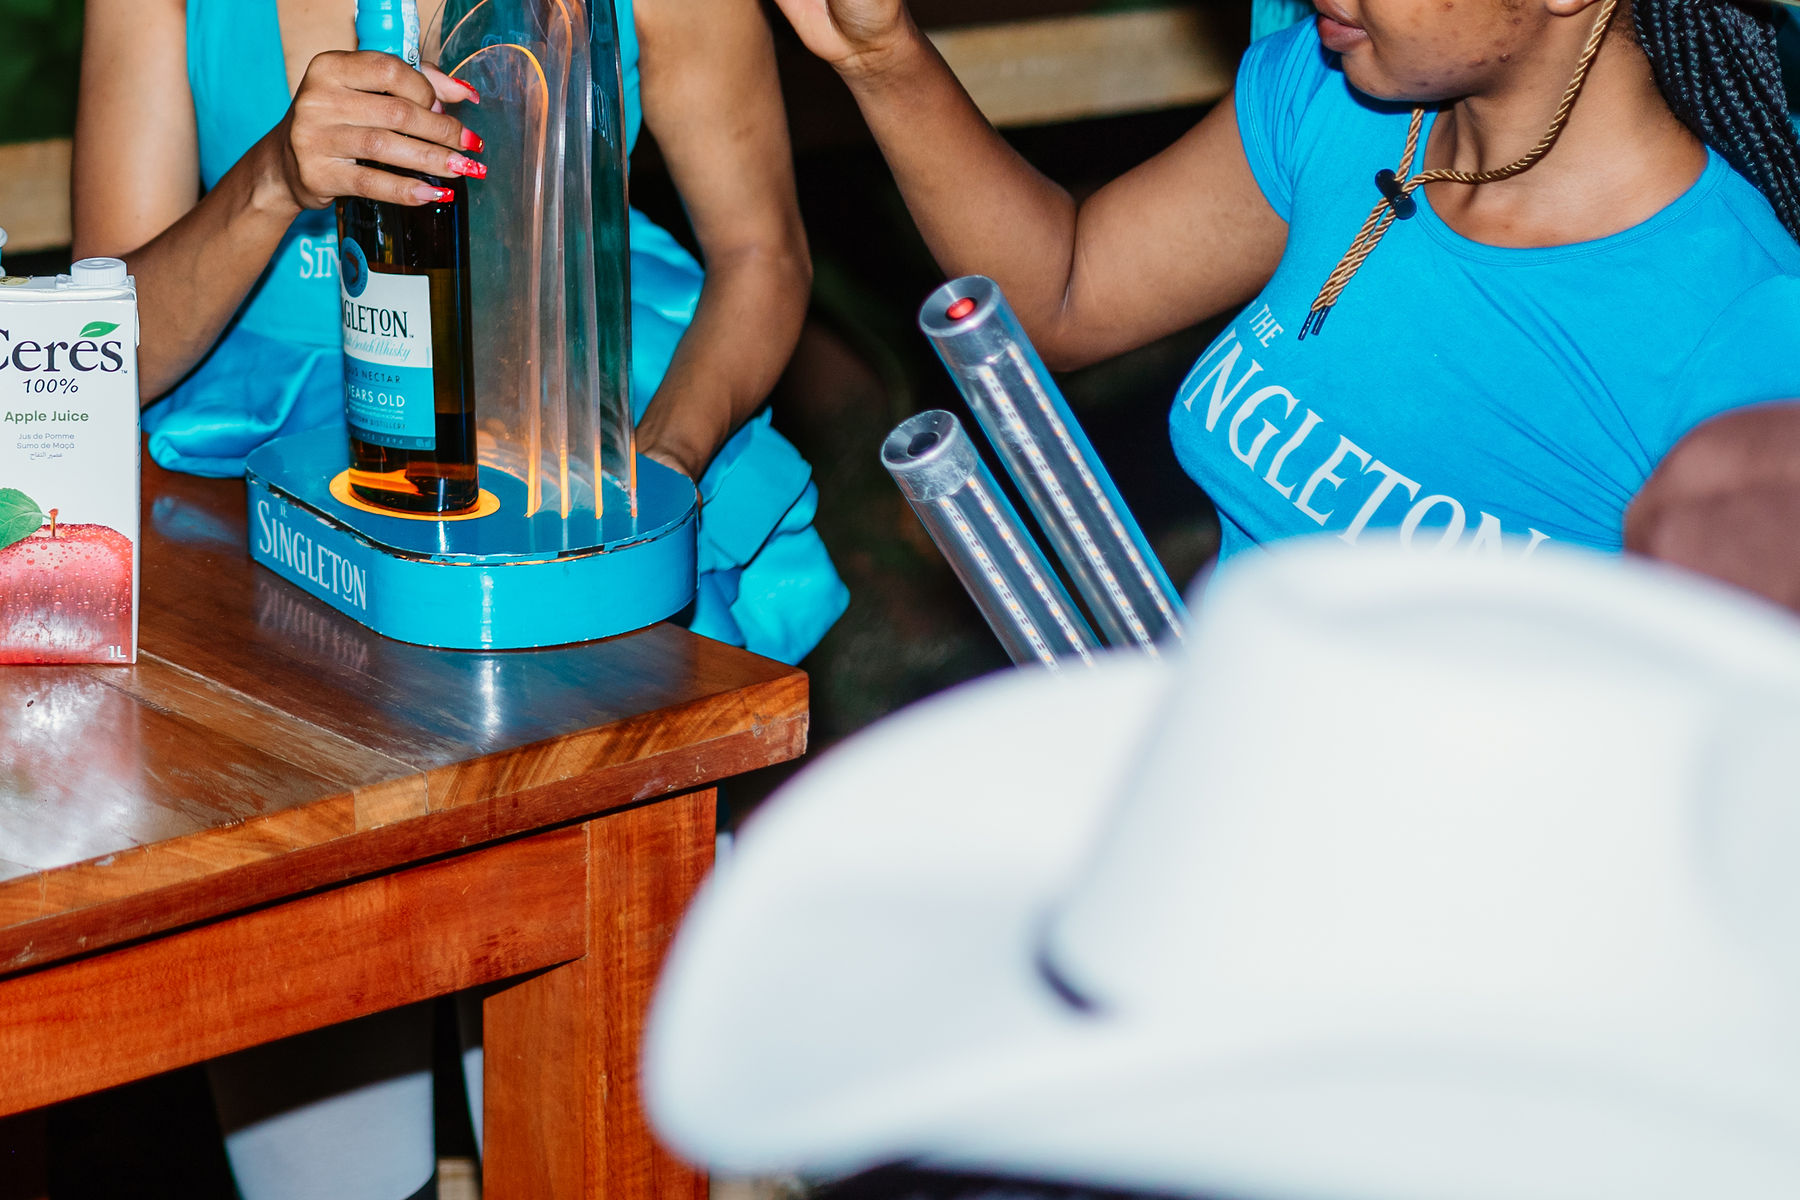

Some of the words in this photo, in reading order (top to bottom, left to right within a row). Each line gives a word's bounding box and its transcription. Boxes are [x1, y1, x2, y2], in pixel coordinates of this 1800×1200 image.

[300, 238, 341, 279] SIN
[343, 299, 408, 338] GLETON
[1249, 303, 1284, 348] THE
[361, 370, 401, 384] NECTAR
[23, 378, 79, 395] 100%
[378, 393, 405, 407] OLD
[4, 410, 47, 424] Apple
[51, 409, 89, 422] Juice
[258, 500, 367, 610] SINGLETON
[108, 645, 127, 658] 1L
